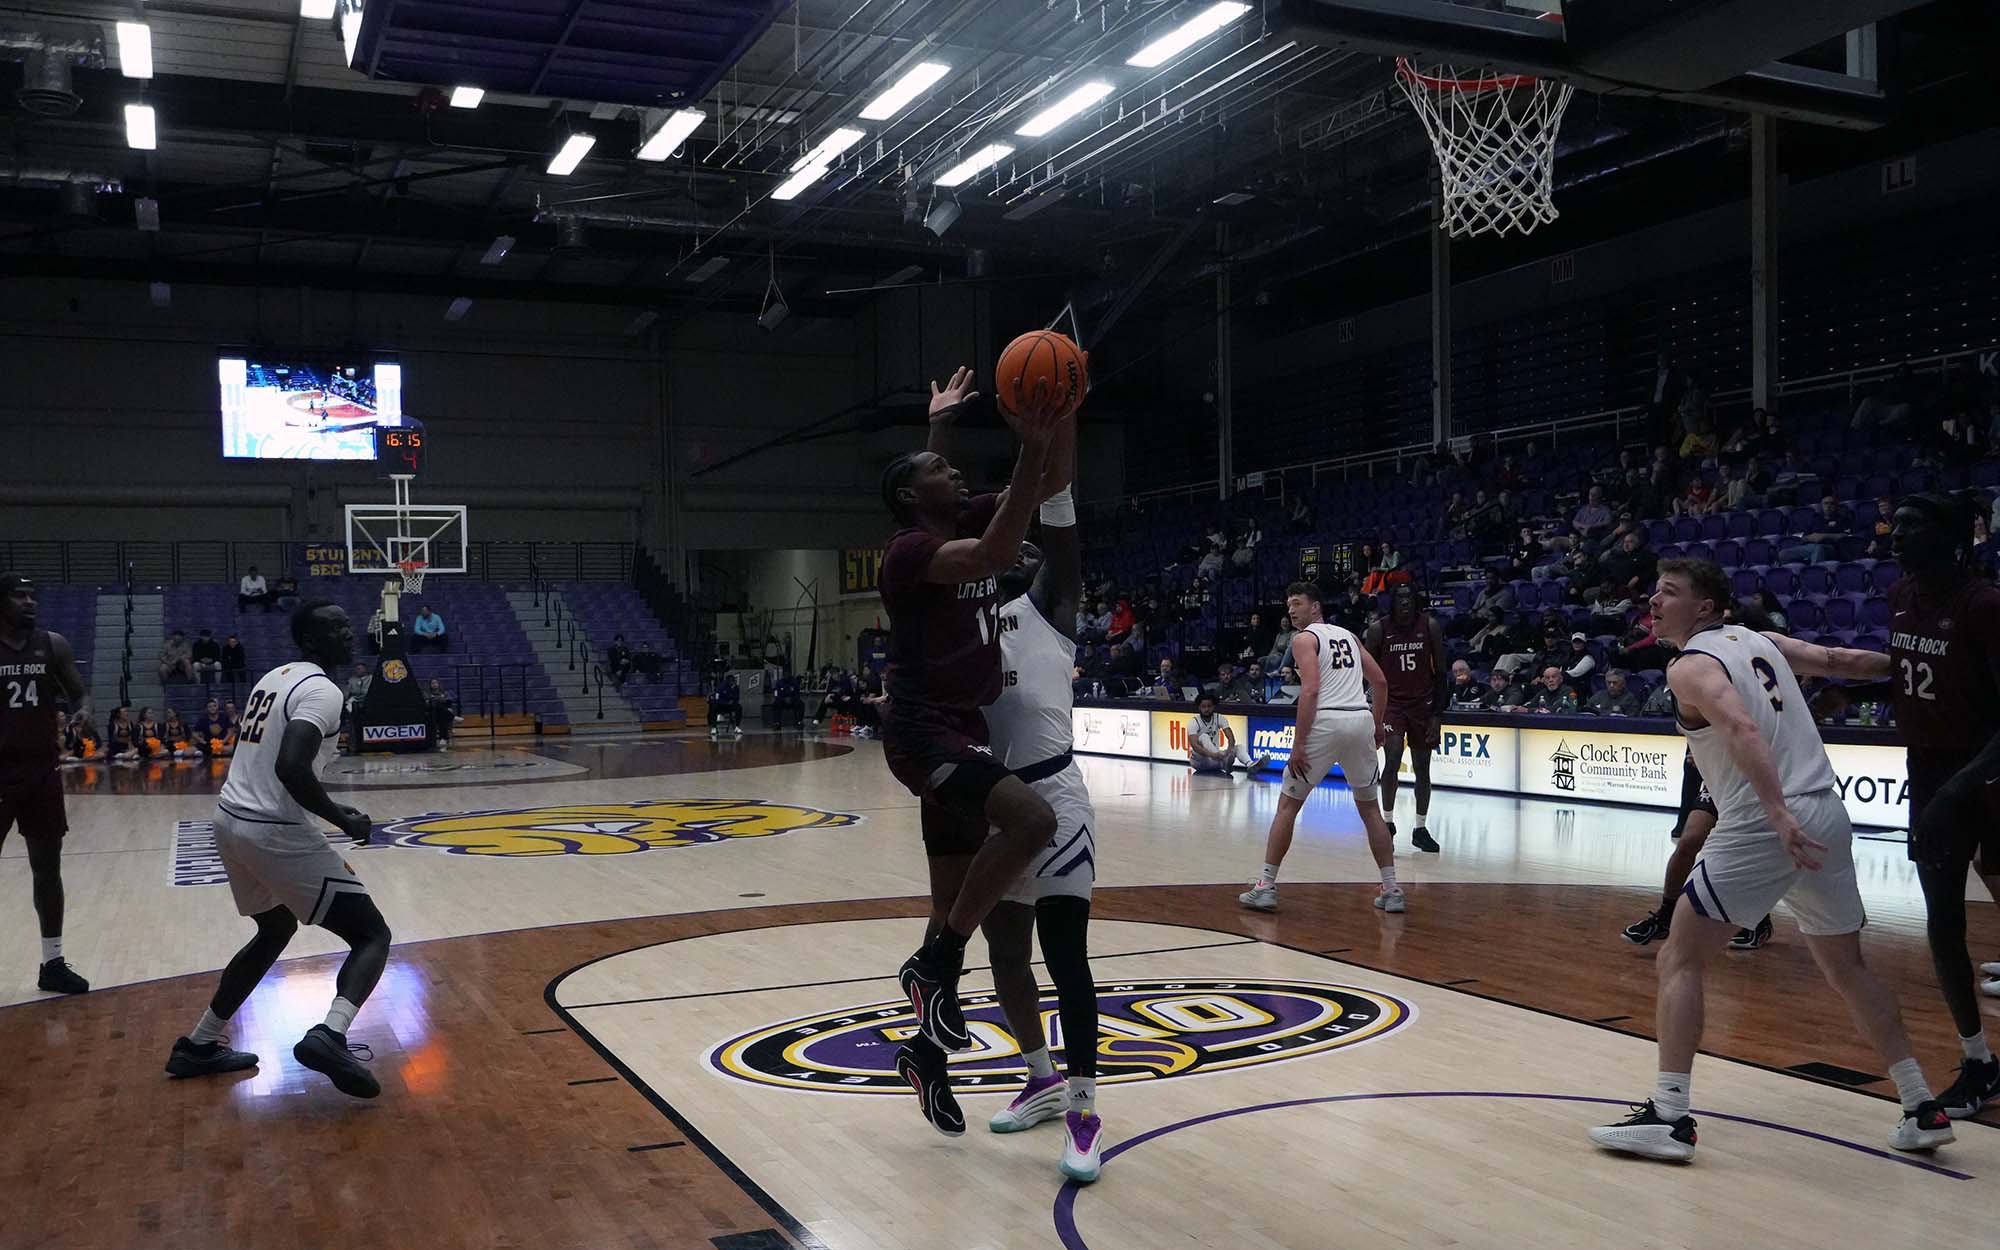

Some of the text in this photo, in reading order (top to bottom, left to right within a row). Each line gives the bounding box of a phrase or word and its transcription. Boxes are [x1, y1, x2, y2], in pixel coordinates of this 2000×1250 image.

[386, 433, 421, 448] 16:15
[1329, 639, 1355, 669] 23
[1389, 643, 1408, 652] LITTLE
[1891, 631, 1949, 656] LITTLE ROCK
[24, 663, 47, 675] ROCK
[1399, 653, 1417, 672] 15
[1900, 658, 1936, 700] 32
[7, 680, 39, 708] 24
[241, 689, 277, 743] 22
[365, 725, 425, 738] WGEM
[1432, 732, 1490, 759] PEX
[1580, 743, 1668, 765] Clock Tower
[1580, 762, 1668, 780] Community Bank
[1256, 1012, 1371, 1052] OHIO
